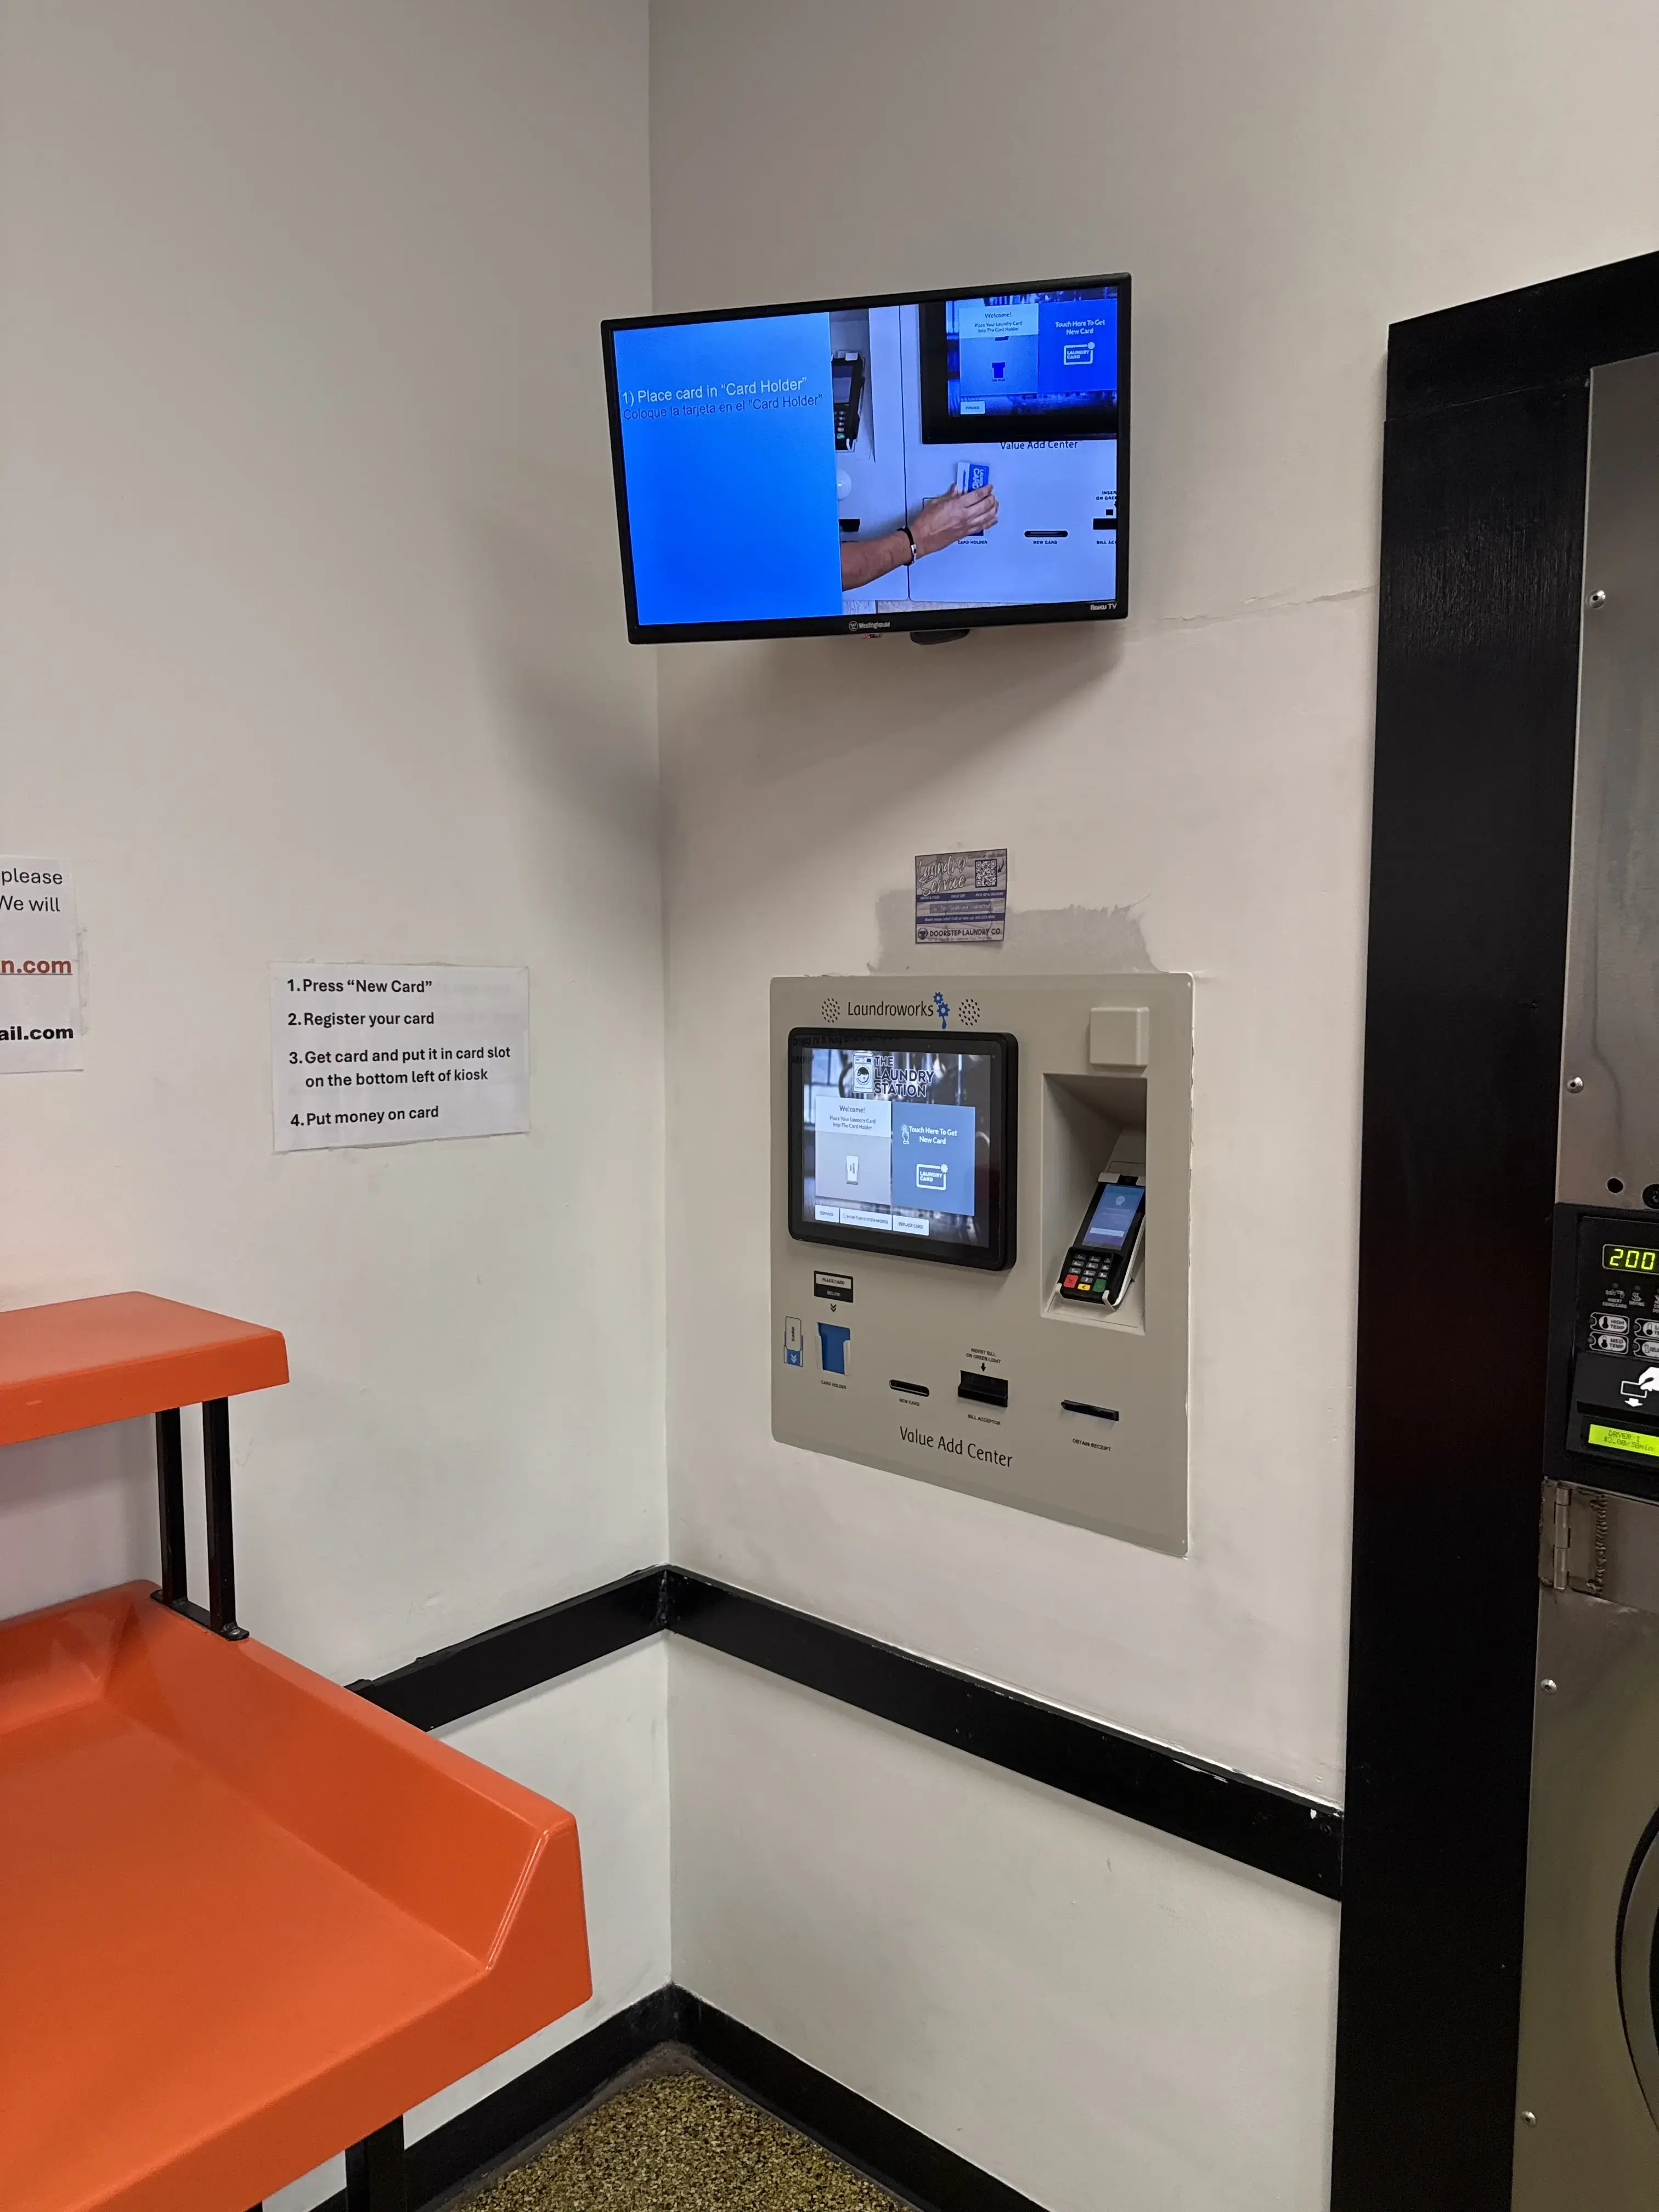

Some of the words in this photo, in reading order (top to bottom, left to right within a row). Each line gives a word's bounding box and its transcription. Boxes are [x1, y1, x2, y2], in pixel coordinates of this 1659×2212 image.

[623, 391, 634, 407] 1)
[638, 389, 672, 403] Place
[675, 386, 702, 400] card
[707, 385, 718, 397] in
[623, 409, 666, 421] Coloque
[670, 407, 679, 416] la
[683, 404, 715, 417] tarjeta
[719, 404, 732, 413] en
[736, 400, 745, 411] el
[1000, 441, 1025, 450] Value
[1027, 441, 1045, 449] Add
[1048, 441, 1077, 449] Center
[2, 867, 63, 885] please
[917, 855, 966, 882] Laundry
[921, 875, 967, 896] Service
[29, 897, 60, 911] will
[0, 960, 72, 974] n.com
[303, 979, 344, 992] Press
[347, 979, 387, 993] “New
[391, 980, 432, 994] Card”
[848, 1001, 934, 1017] Laundroworks
[304, 1012, 365, 1028] Register
[369, 1014, 400, 1028] your
[404, 1012, 435, 1025] card
[305, 1051, 332, 1064] Get
[335, 1049, 368, 1063] card
[372, 1049, 398, 1062] and
[402, 1048, 425, 1064] put
[428, 1047, 438, 1060] it
[441, 1047, 453, 1059] in
[455, 1047, 484, 1059] card
[487, 1046, 511, 1058] slot
[874, 1055, 894, 1066] THE
[306, 1077, 324, 1088] on
[328, 1074, 352, 1086] the
[356, 1072, 408, 1086] bottom
[411, 1070, 435, 1083] left
[438, 1070, 452, 1082] of
[454, 1068, 488, 1081] kiosk
[874, 1068, 934, 1084] LAUNDRY
[874, 1082, 927, 1097] STATION
[307, 1113, 331, 1125] Put
[335, 1110, 385, 1124] money
[388, 1109, 405, 1121] on
[409, 1105, 439, 1119] card
[839, 1105, 865, 1113] Welcome!
[909, 1125, 924, 1133] Touch
[1610, 1248, 1656, 1270] 200
[832, 1381, 847, 1390] HOLDER
[1608, 1430, 1632, 1440] DRYER
[900, 1425, 934, 1448] Value
[937, 1435, 963, 1455] Add
[967, 1443, 1013, 1468] Center
[1072, 1438, 1090, 1447] OBTAIN
[1091, 1442, 1111, 1452] RECEIPT
